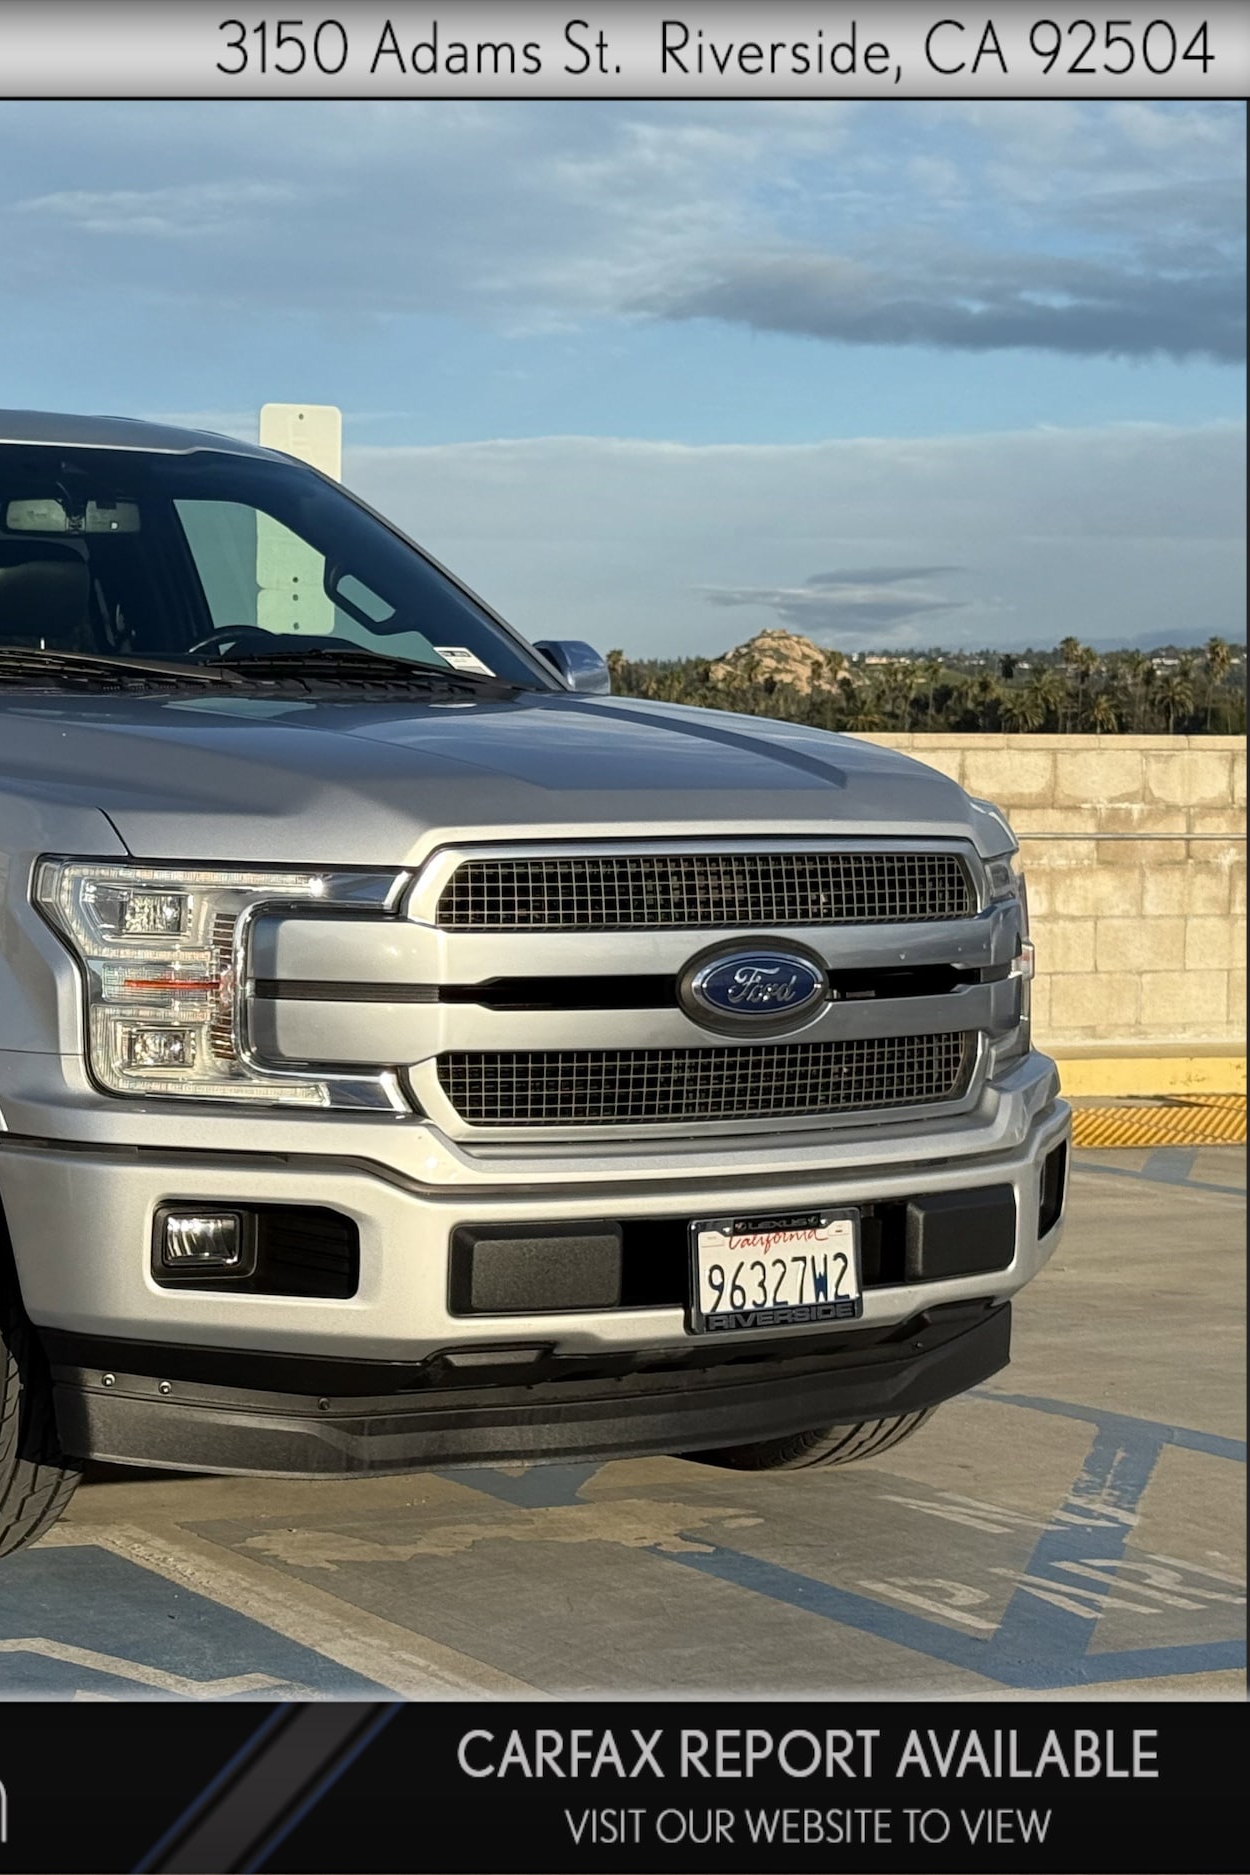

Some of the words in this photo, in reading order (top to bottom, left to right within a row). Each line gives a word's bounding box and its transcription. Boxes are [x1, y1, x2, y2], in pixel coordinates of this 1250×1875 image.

[727, 966, 798, 1004] Ford
[748, 1217, 808, 1230] LEXUS
[728, 1229, 828, 1255] California
[707, 1252, 851, 1314] 96327W2
[707, 1303, 854, 1331] RIVERSIDE
